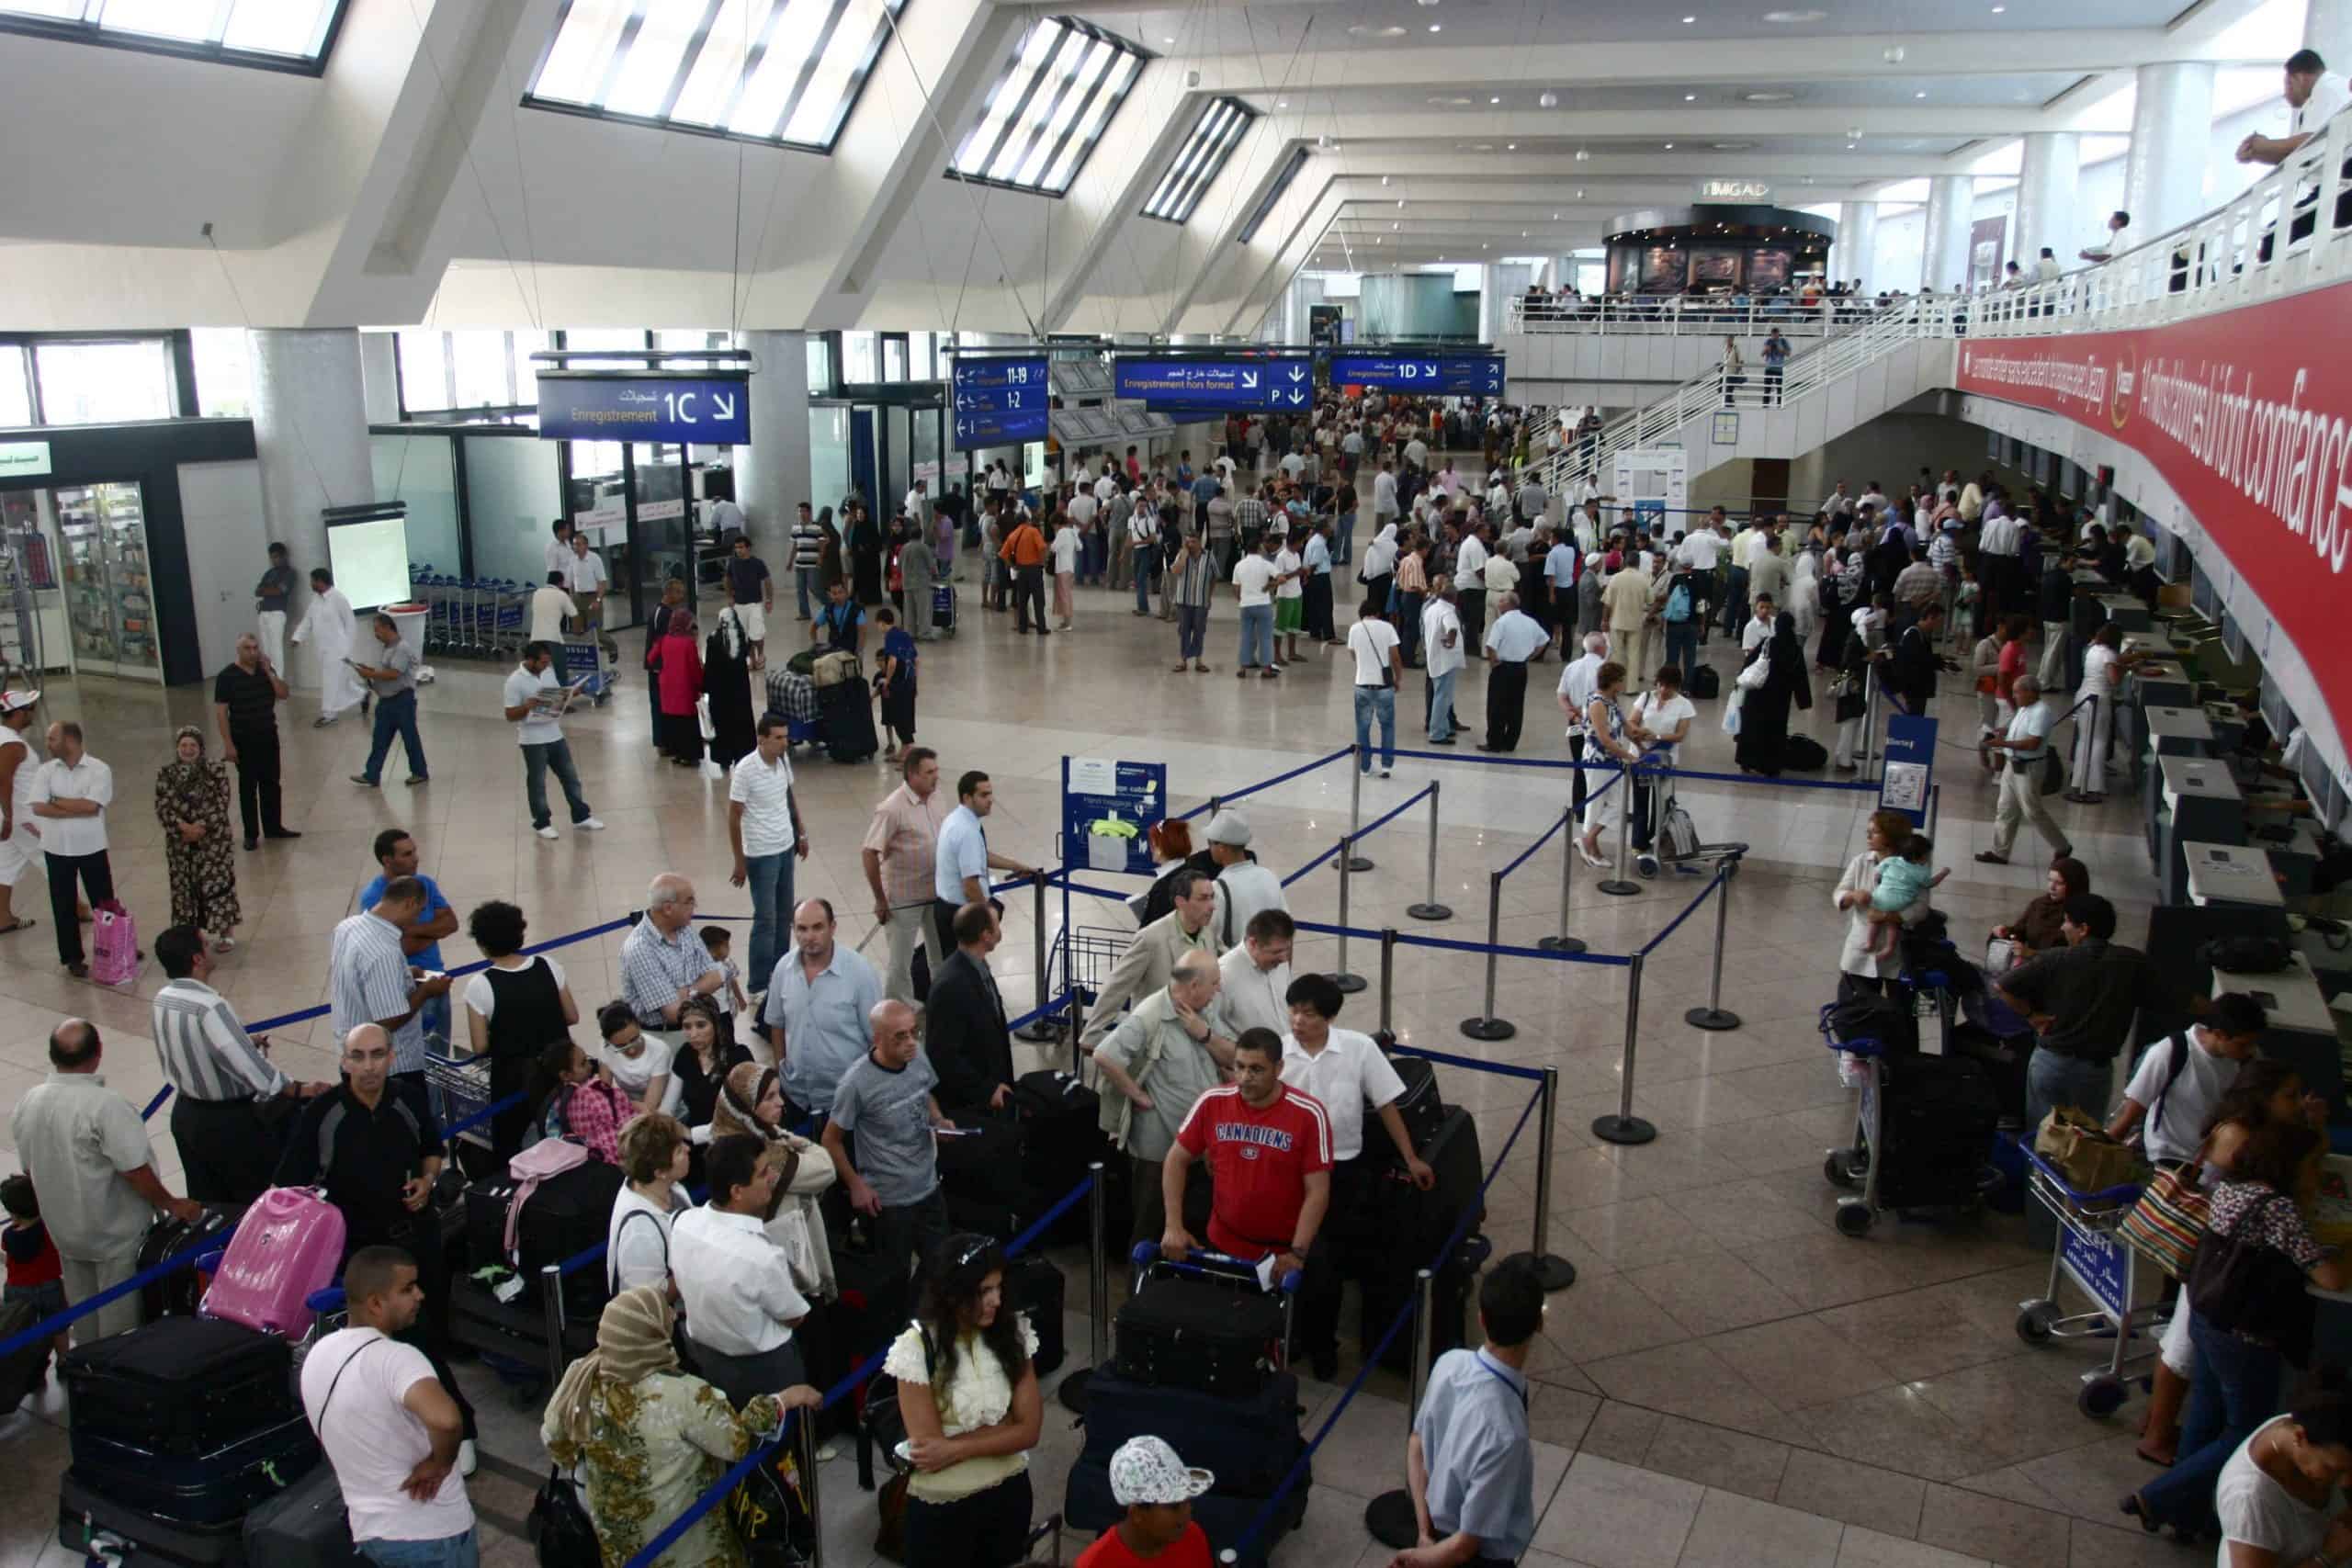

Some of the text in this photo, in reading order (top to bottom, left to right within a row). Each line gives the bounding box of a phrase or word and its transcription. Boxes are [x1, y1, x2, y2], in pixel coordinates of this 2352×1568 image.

[1007, 367, 1027, 384] 11-19
[1398, 364, 1417, 378] 1D
[1124, 378, 1236, 390] Enregistrement hors format
[663, 392, 698, 423] 1C
[1007, 390, 1021, 409] 1-2
[572, 407, 658, 424] Enregistrement
[2218, 365, 2251, 488] font
[2244, 367, 2352, 575] confiance
[1216, 1122, 1293, 1152] CANADIENS
